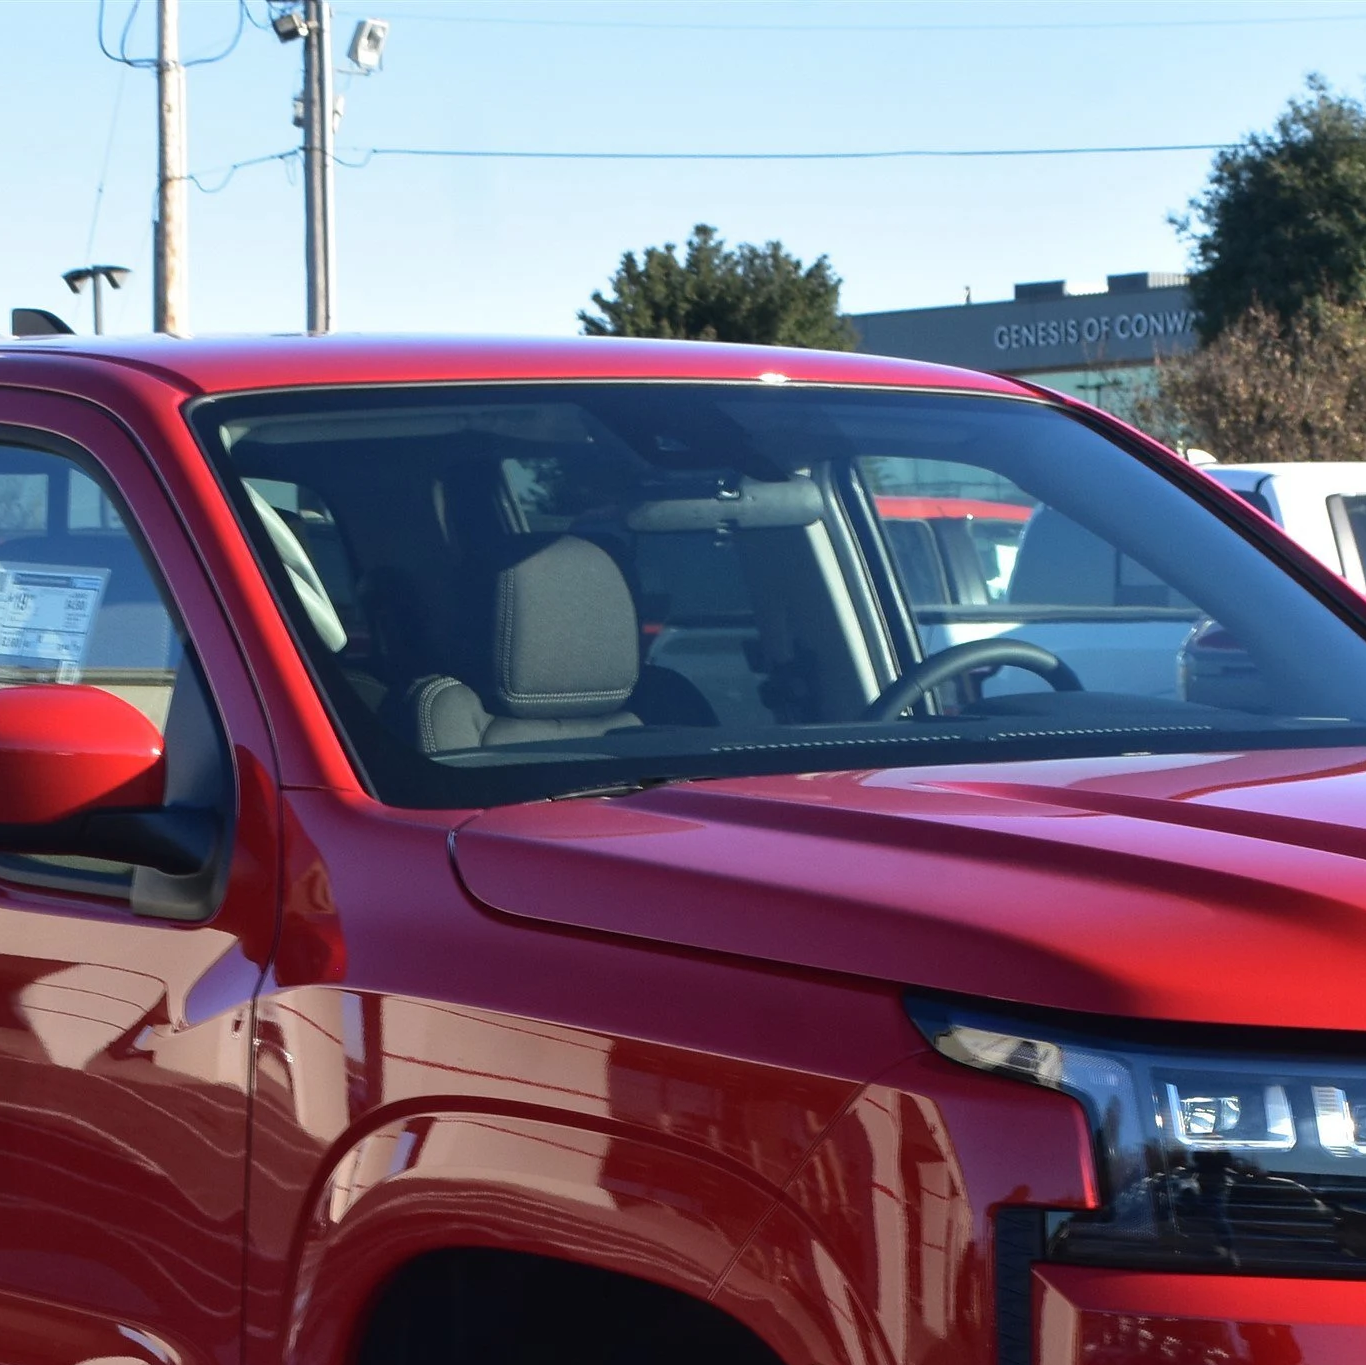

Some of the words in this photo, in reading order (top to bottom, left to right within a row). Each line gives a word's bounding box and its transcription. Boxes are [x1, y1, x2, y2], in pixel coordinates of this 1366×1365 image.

[993, 317, 1080, 350] GENESIS
[1082, 315, 1111, 343] OF
[1114, 309, 1205, 340] CONWA
